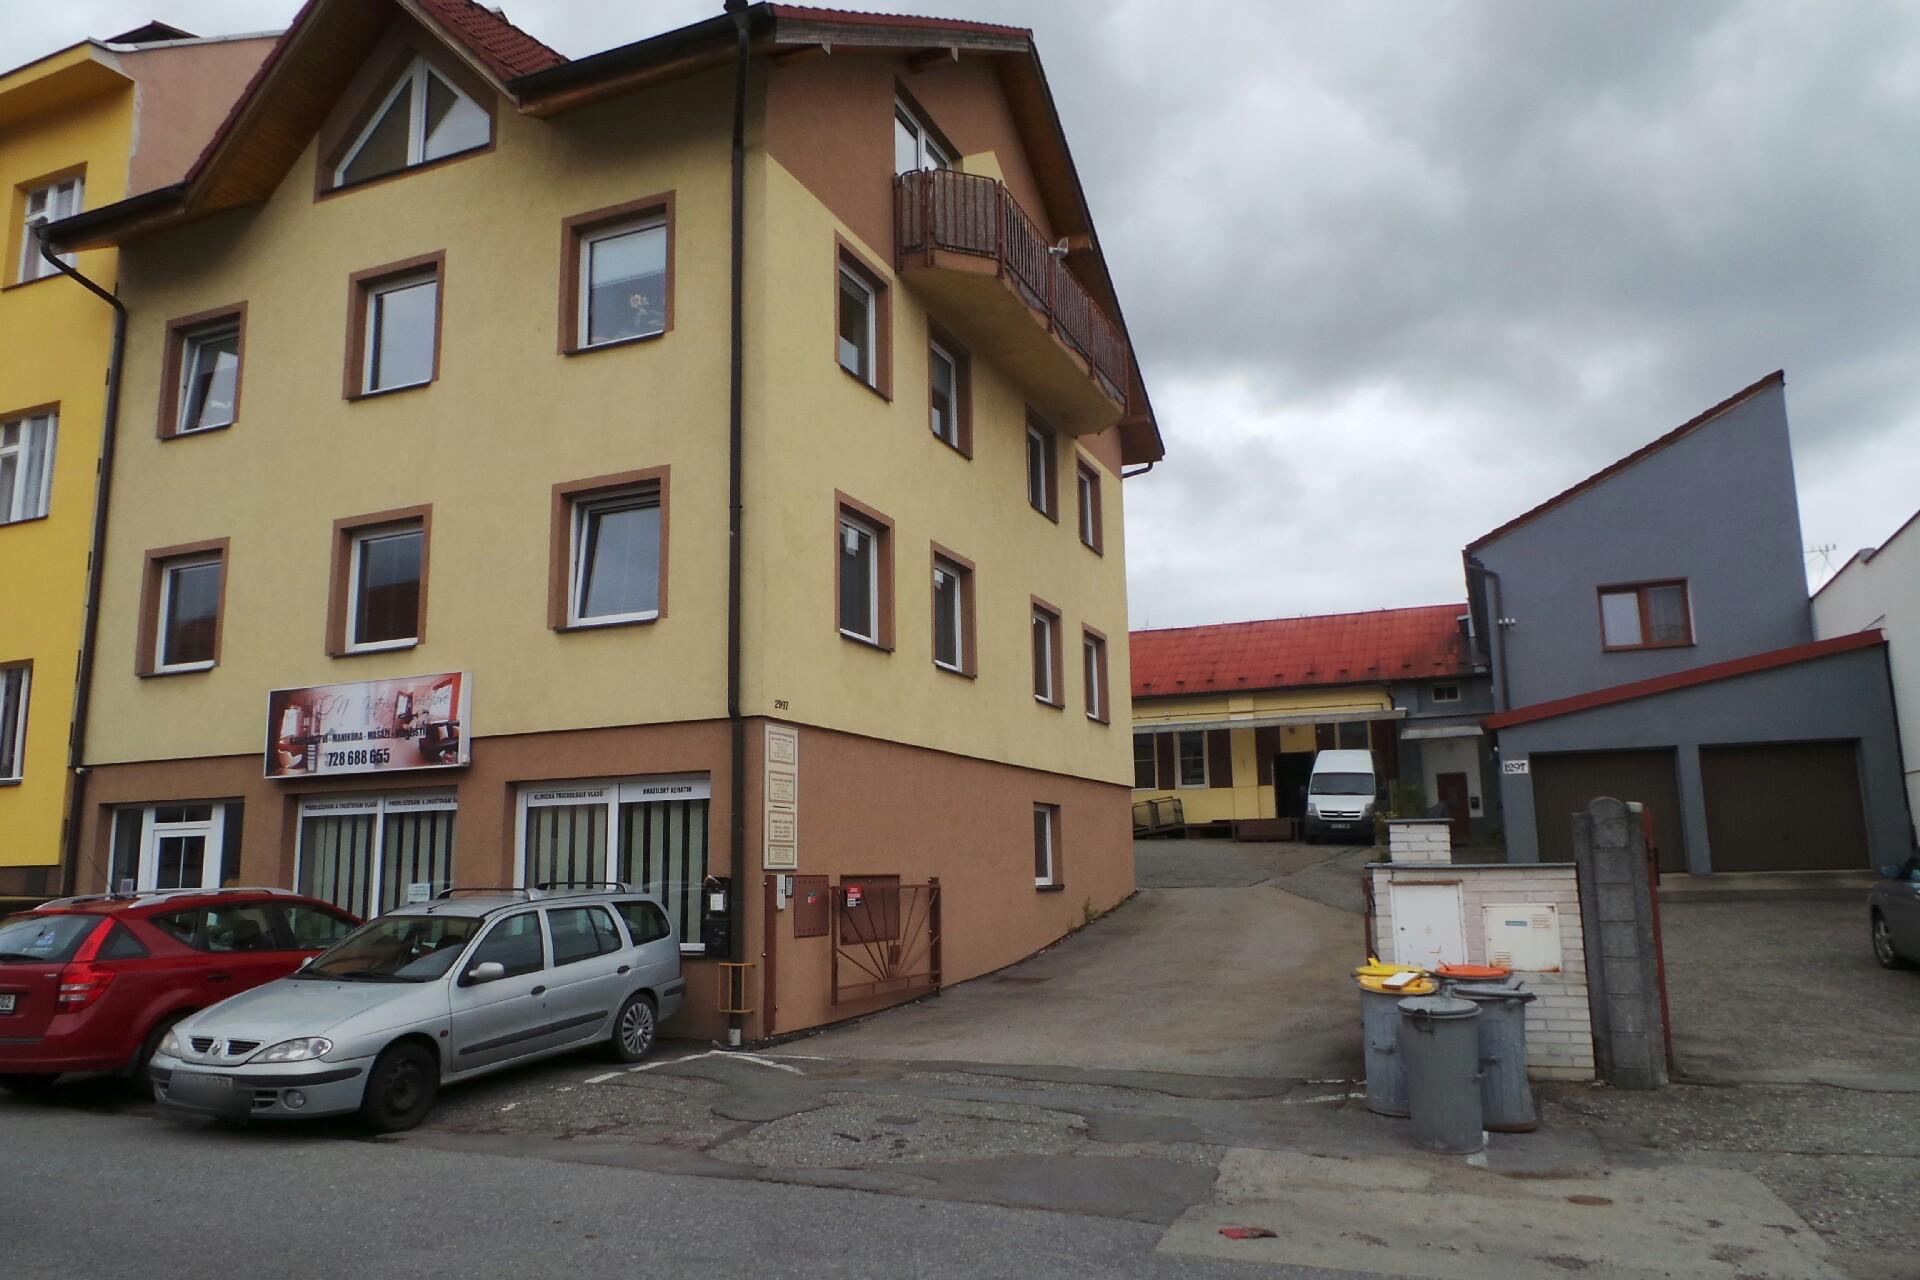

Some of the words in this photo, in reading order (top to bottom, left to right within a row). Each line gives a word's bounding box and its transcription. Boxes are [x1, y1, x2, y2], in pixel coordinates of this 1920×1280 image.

[328, 752, 345, 767] 728
[348, 750, 367, 765] 688
[370, 748, 390, 764] 655
[1505, 763, 1526, 772] 1297
